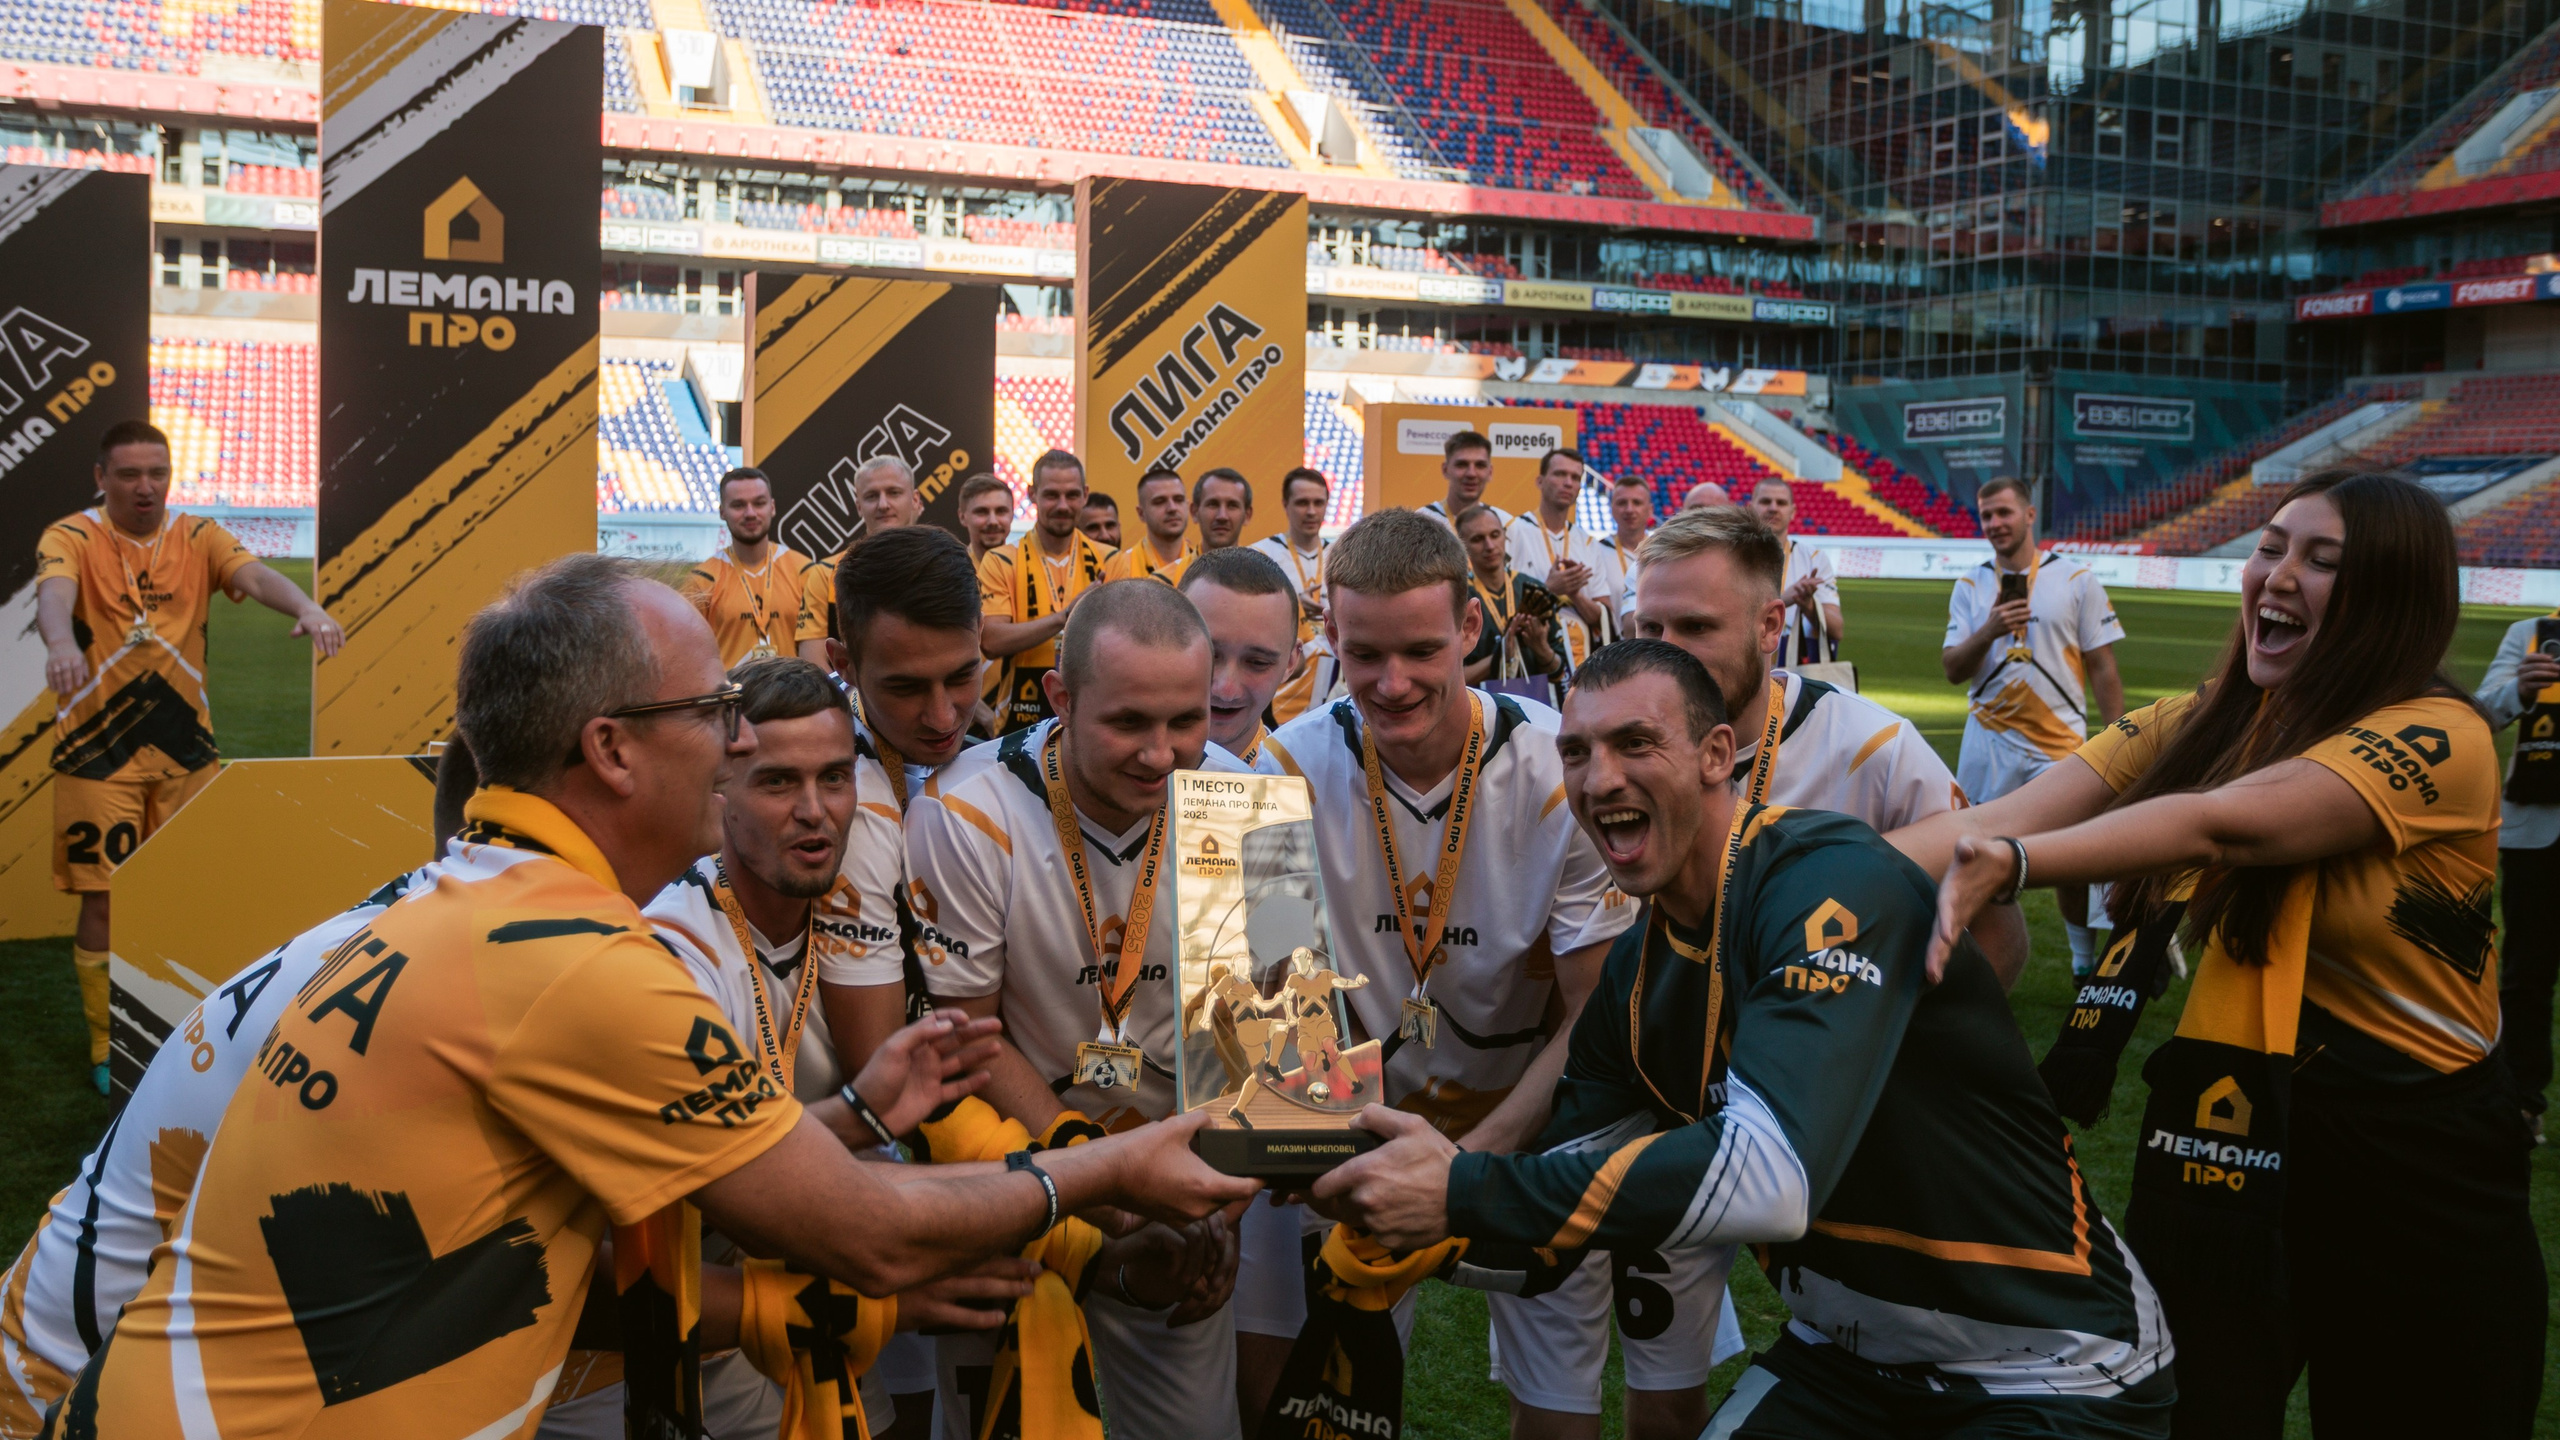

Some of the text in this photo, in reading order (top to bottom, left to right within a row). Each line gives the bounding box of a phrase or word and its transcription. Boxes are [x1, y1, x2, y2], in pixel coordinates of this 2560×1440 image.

[729, 236, 811, 253] APOTHEKA
[949, 252, 1025, 267] APOTHEKA
[348, 267, 575, 315] ЛЕМАНА
[1523, 288, 1586, 304] APOTHEKA
[1689, 299, 1747, 314] APOTHEKA
[2302, 295, 2368, 317] FONBET
[2456, 277, 2533, 302] FONBET
[408, 311, 517, 352] ПРО
[1109, 300, 1265, 464] ЛИГА
[1233, 343, 1283, 397] ПРО
[45, 360, 117, 424] ПРО
[1495, 433, 1555, 450] просебя
[917, 448, 970, 504] ПРО
[1764, 714, 1778, 748] ЛИГА
[1047, 749, 1060, 781] ЛИГА
[2349, 743, 2409, 792] ПРО
[1182, 779, 1245, 794] 1 МЕСТО
[1183, 797, 1278, 811] ЛЕМАНА ПРО ЛИГА
[1183, 810, 1208, 820] 2025
[1362, 733, 1407, 918] ЛИГА ЛЕМАНА ПРО 2025
[1432, 730, 1480, 918] ЛИГА ЛЕМАНА ПРО 2025
[67, 821, 137, 867] 20
[1050, 787, 1097, 939] ЛЕМАНА ПРО 2025
[1142, 860, 1157, 888] ПРО
[1185, 857, 1237, 867] ЛЕМАНА
[1199, 867, 1223, 876] ПРО
[719, 894, 754, 957] 2025
[1124, 892, 1153, 954] 2025
[814, 933, 868, 958] ПРО
[1784, 965, 1850, 994] ПРО
[754, 994, 778, 1056] ЛЕМАНА
[793, 1002, 806, 1032] ПРО
[2069, 1007, 2102, 1029] ПРО
[183, 1003, 215, 1073] ПРО
[1099, 1045, 1121, 1053] ЛЕМАНА
[263, 1041, 338, 1111] ПРО
[659, 1060, 762, 1126] ЛЕМА
[713, 1075, 777, 1129] ПРО
[1267, 1145, 1356, 1155] МАГАЗИН ЧЕРЕПОВЕЦ
[2147, 1128, 2282, 1171] ЛЕМАНА
[2182, 1161, 2246, 1192] ПРО
[1611, 1249, 1674, 1340] 6
[1279, 1393, 1393, 1440] ЛЕМАНА
